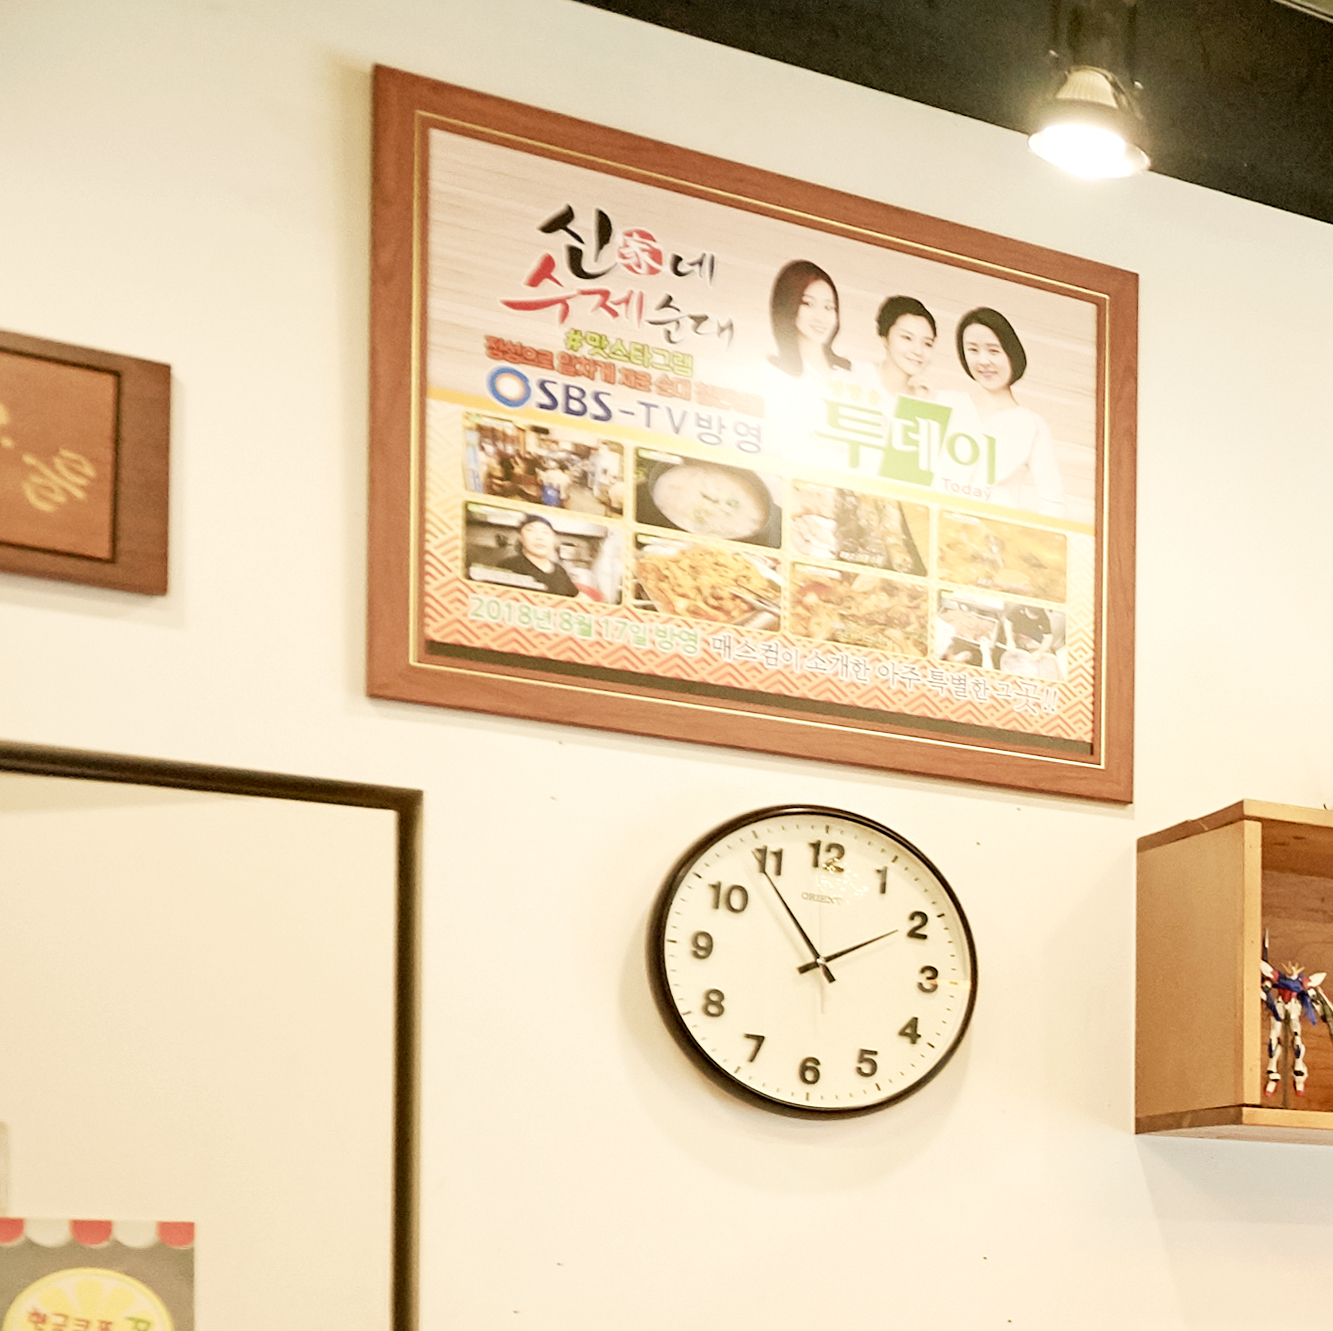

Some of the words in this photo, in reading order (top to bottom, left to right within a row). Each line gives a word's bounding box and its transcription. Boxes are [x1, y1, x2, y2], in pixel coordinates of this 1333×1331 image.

[565, 328, 693, 377] #맛스타그램
[813, 399, 996, 486] 투데이
[941, 477, 993, 501] Today
[469, 596, 553, 631] 2018년
[559, 609, 594, 638] 8월
[602, 618, 648, 647] 17일
[655, 627, 700, 655] 방영
[805, 652, 870, 684] 소개한
[877, 661, 921, 689] 아주
[928, 668, 990, 701] 특별한
[753, 845, 783, 876] 11
[808, 839, 845, 873] 12
[875, 866, 888, 895] 1
[708, 881, 749, 913] 10
[906, 910, 929, 940] 2
[691, 930, 714, 960] 9
[917, 965, 939, 993] 3
[702, 988, 725, 1018] 8
[898, 1016, 922, 1044] 4
[743, 1033, 765, 1063] 7
[855, 1048, 878, 1078] 5
[799, 1056, 821, 1085] 6
